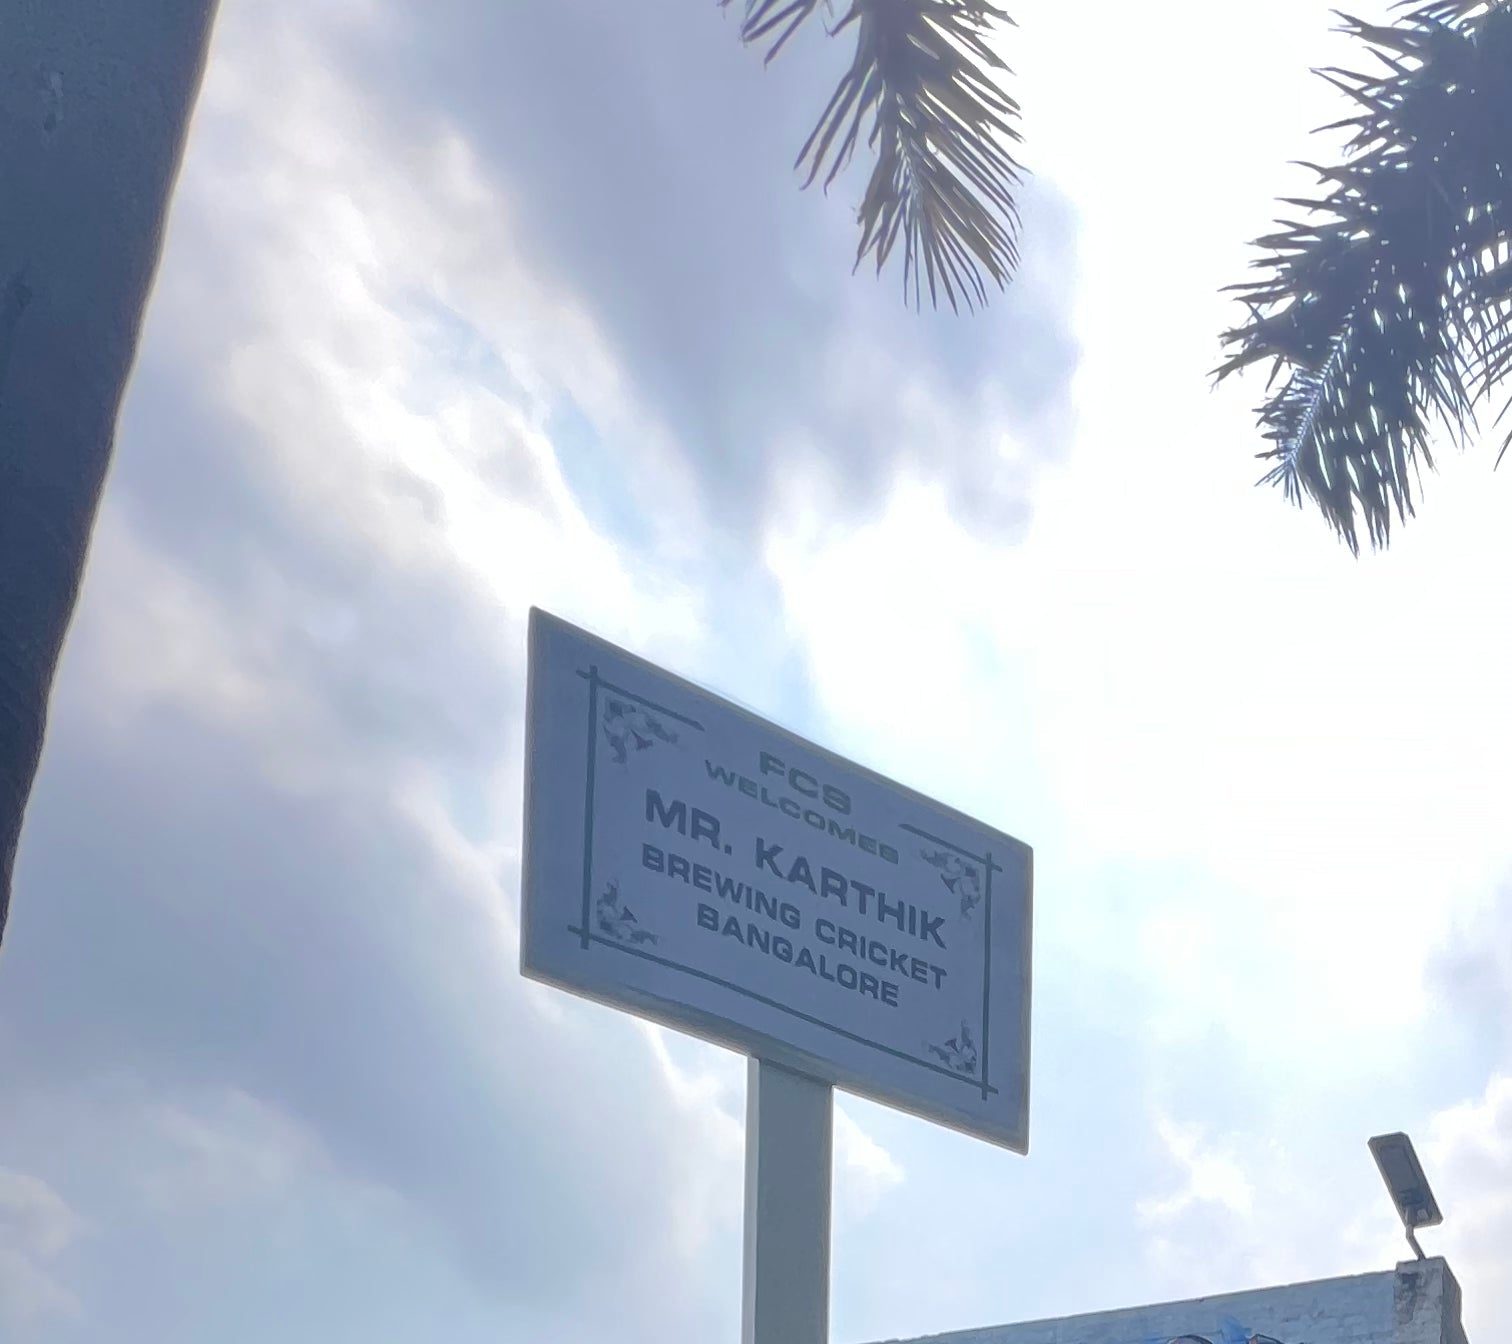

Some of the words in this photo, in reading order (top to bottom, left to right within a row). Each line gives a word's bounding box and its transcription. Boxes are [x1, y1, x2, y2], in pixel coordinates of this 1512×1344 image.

[705, 759, 900, 865] WELCOMES
[759, 751, 851, 816] FCS
[641, 843, 801, 931] BREWING
[815, 919, 948, 990] CRICKET
[645, 789, 733, 856] MR.
[755, 836, 946, 950] KARTHIK
[697, 901, 900, 1008] BANGALORE
